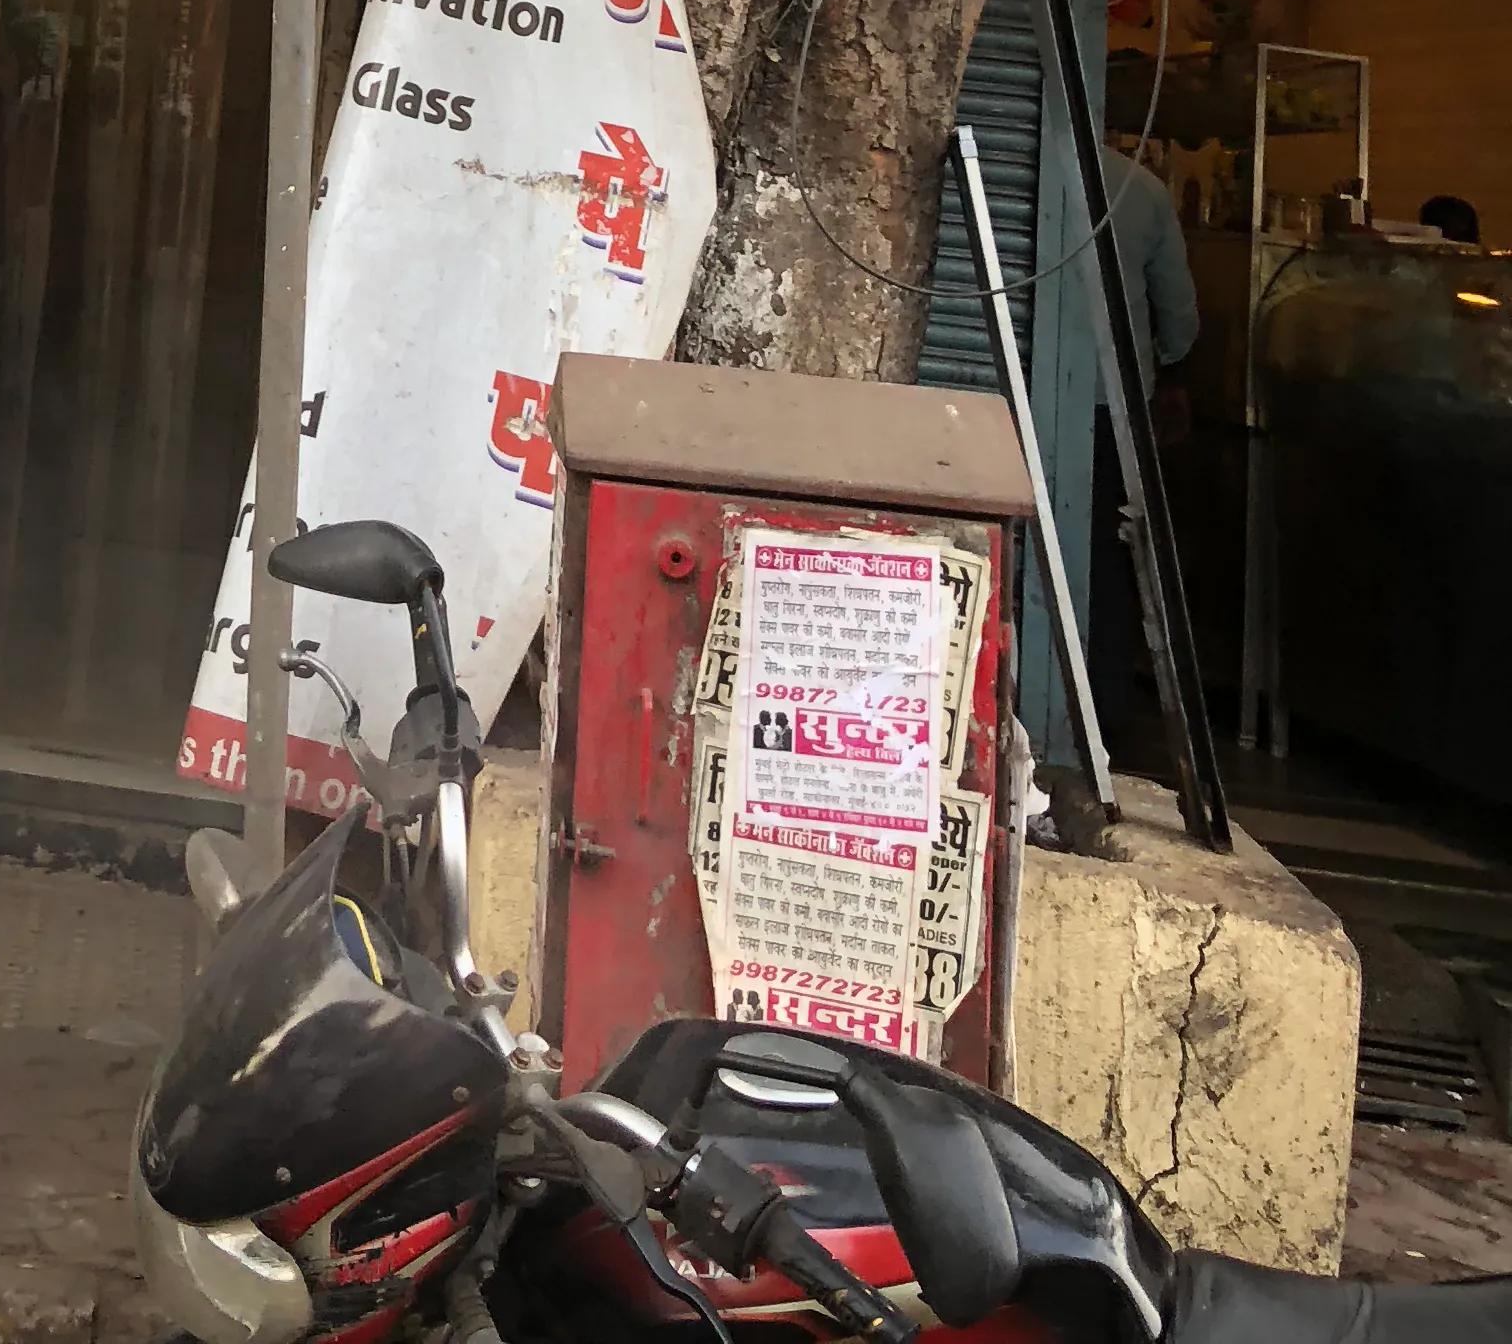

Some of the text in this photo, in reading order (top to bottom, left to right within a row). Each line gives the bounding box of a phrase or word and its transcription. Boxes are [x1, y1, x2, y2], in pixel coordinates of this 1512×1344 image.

[351, 60, 476, 133] Glass
[755, 682, 928, 714] 998722723
[729, 959, 903, 1006] 9987272723
